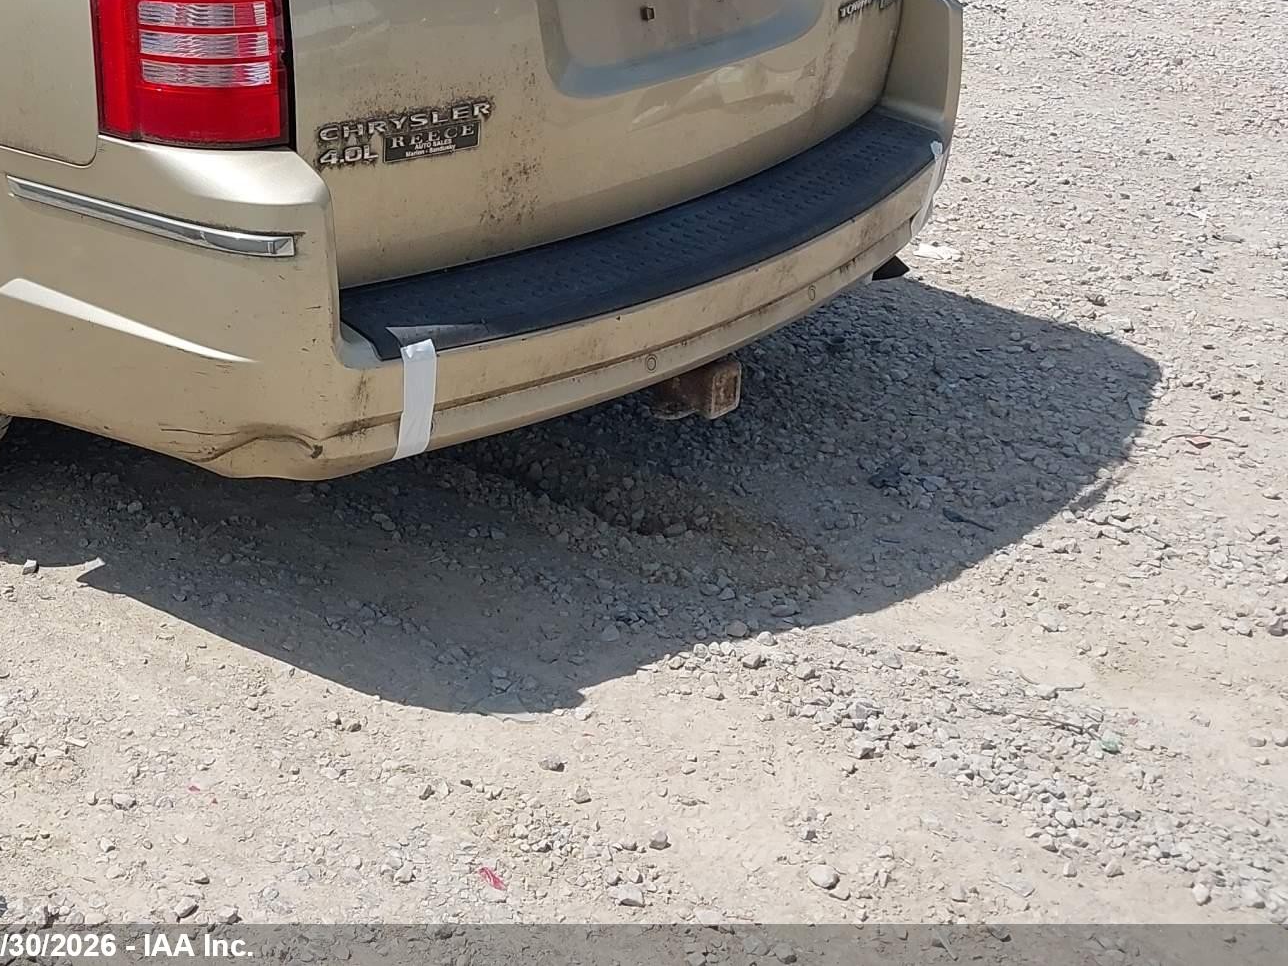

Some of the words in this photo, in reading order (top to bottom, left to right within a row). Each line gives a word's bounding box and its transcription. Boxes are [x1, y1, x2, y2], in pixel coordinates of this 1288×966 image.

[319, 101, 492, 142] CHRYSLER
[390, 124, 475, 149] REECE
[414, 141, 432, 151] AUTO
[432, 138, 453, 148] SALES
[319, 144, 379, 164] 4.0L
